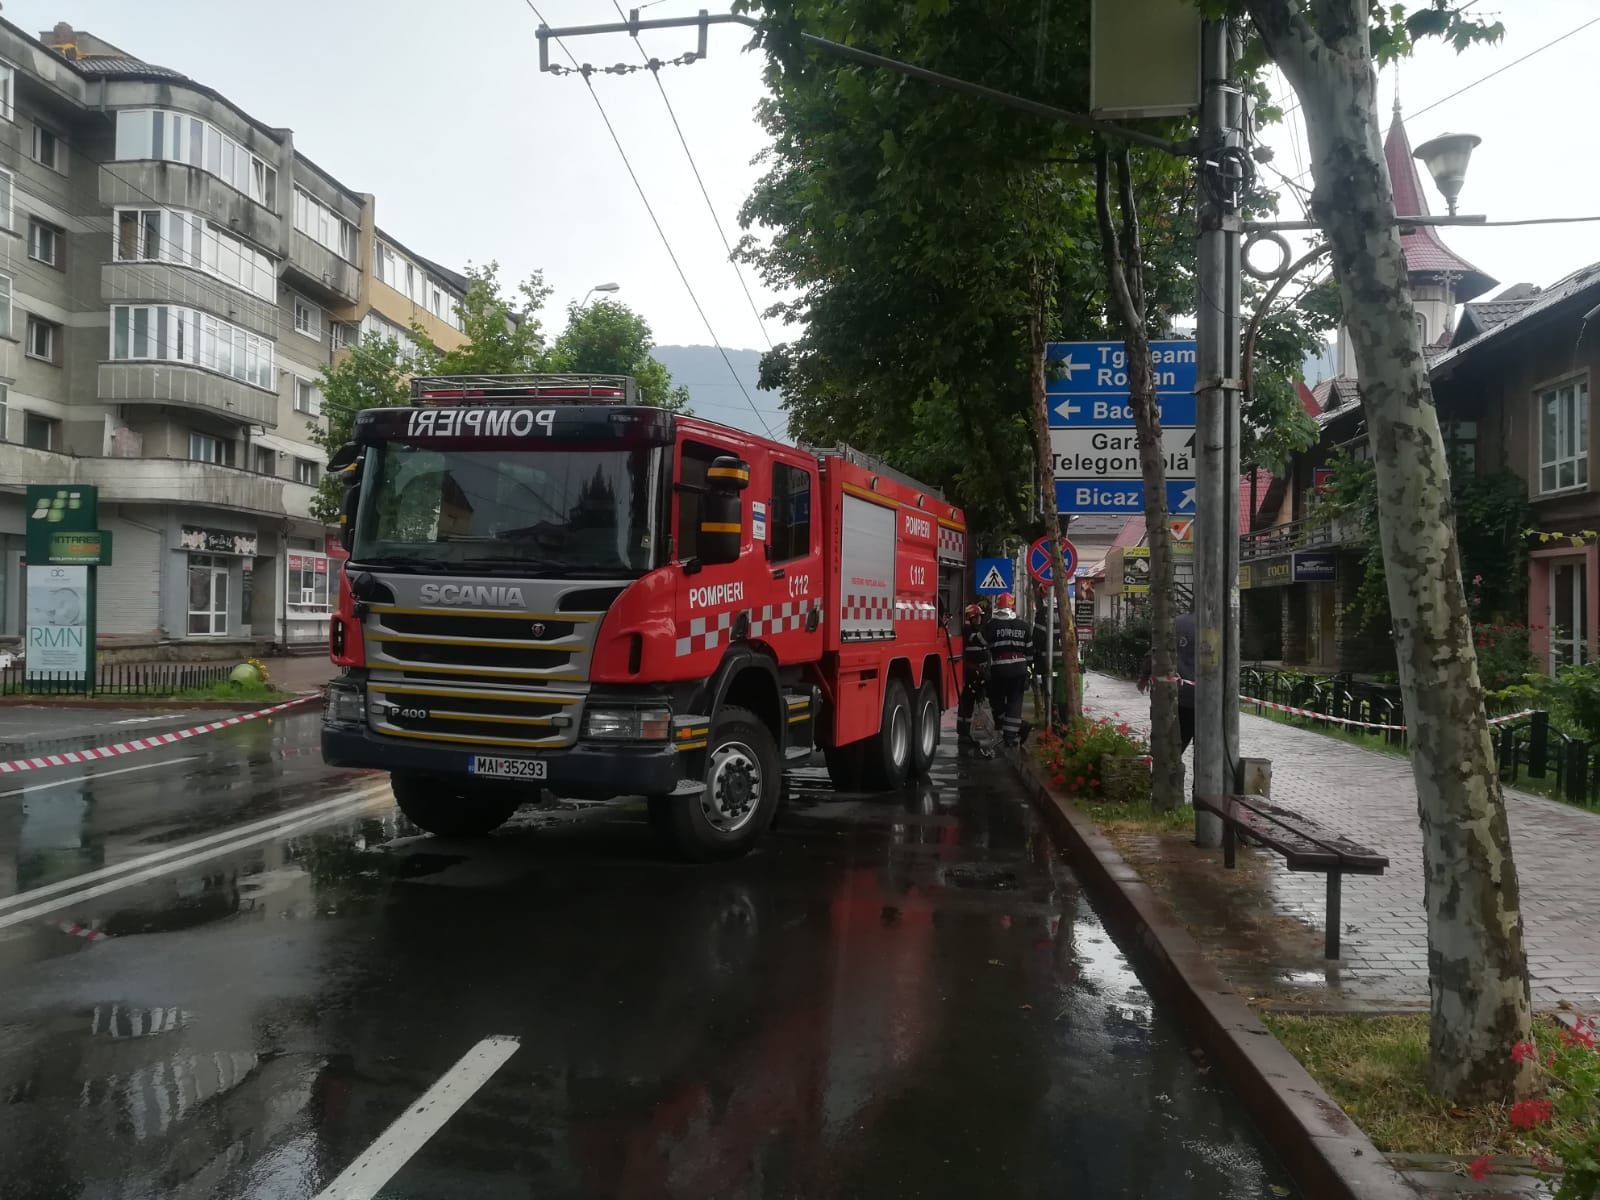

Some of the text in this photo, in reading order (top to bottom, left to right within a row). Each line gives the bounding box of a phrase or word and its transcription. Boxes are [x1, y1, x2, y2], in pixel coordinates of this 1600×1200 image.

[1097, 368, 1175, 386] Roan
[1076, 488, 1139, 506] Bicaz
[905, 515, 930, 539] POMPIERI
[914, 565, 925, 585] 112
[420, 583, 526, 608] SCANIA
[689, 581, 744, 608] POMPIERI
[794, 575, 809, 596] 112
[30, 627, 83, 648] RMN
[391, 707, 427, 719] P 400
[477, 757, 499, 774] MAI
[503, 760, 544, 777] 35293
